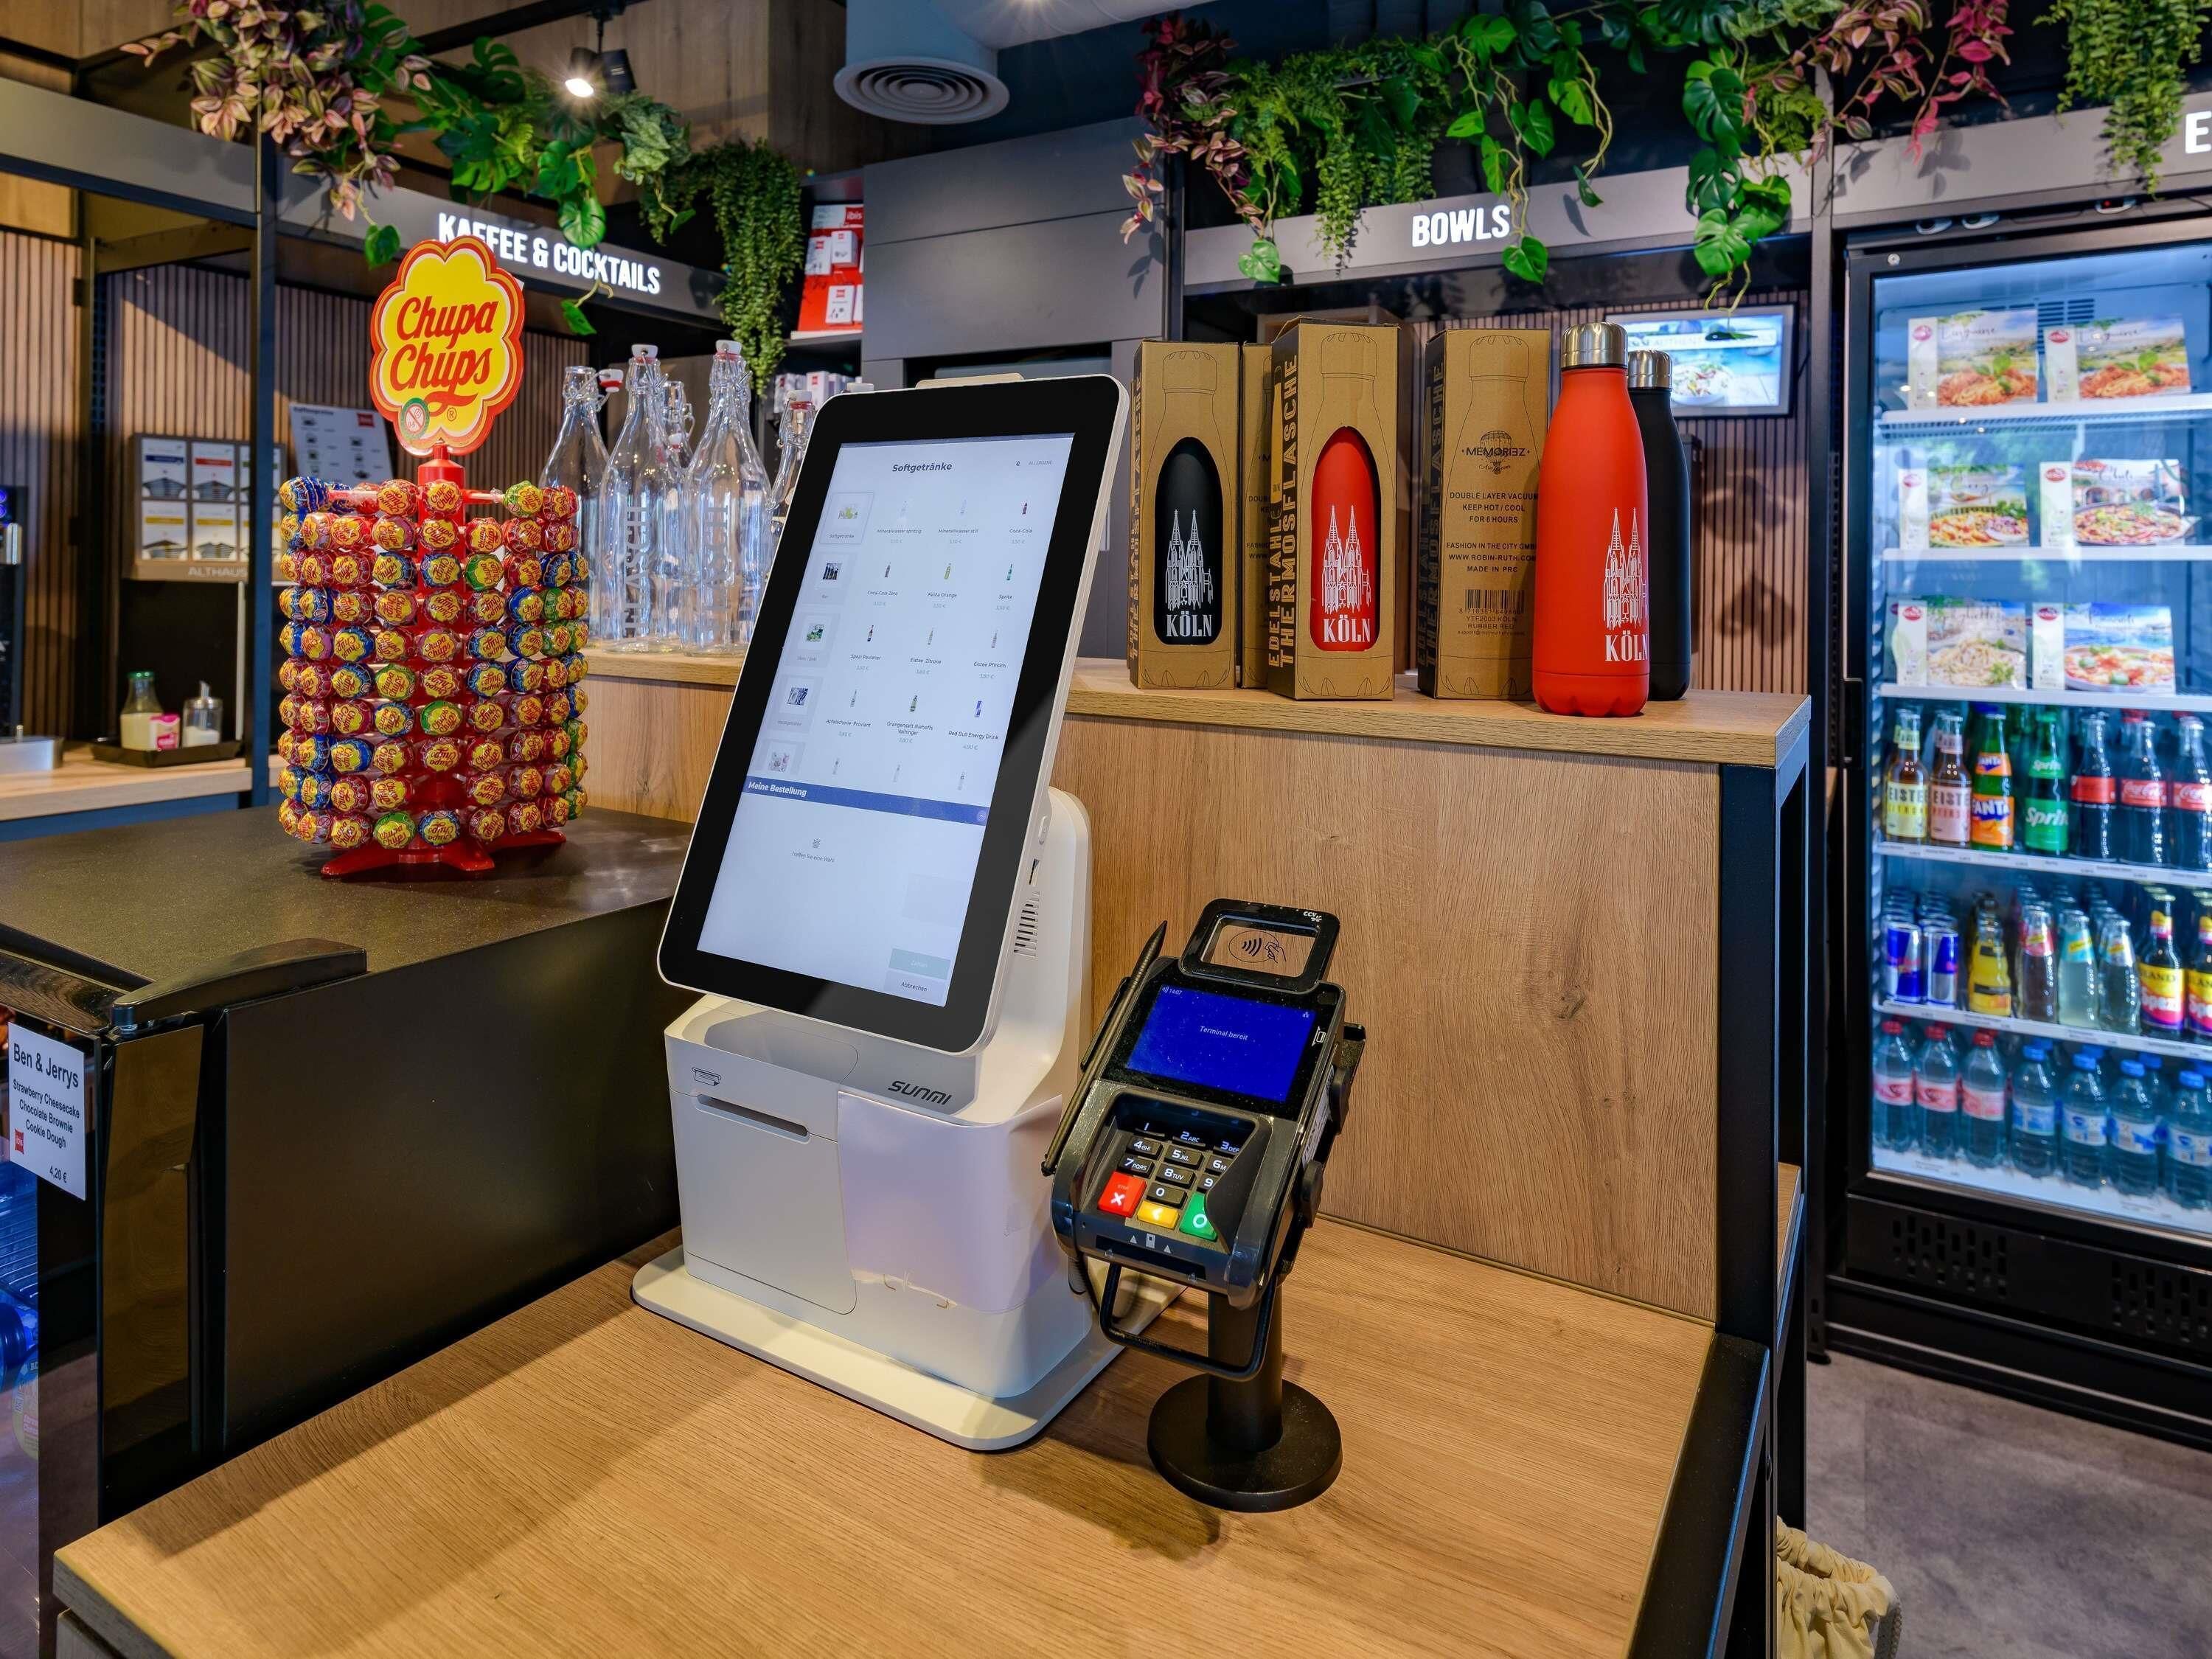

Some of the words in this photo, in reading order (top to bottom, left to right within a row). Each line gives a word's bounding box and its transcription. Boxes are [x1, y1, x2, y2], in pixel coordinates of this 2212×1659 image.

[1411, 204, 1510, 247] BOWLS
[438, 212, 528, 264] KAFFEE
[532, 237, 549, 268] &
[554, 243, 661, 294] COCKTAILS
[396, 296, 499, 349] Chupa
[389, 341, 493, 404] Chups
[892, 462, 953, 473] Softgetränke
[1281, 355, 1298, 668] THERMOSFLASCHE
[1450, 492, 1480, 500] DOUBLE
[1268, 518, 1282, 668] EDELSTAHL
[1166, 611, 1212, 637] KÖLN
[1324, 615, 1371, 643] KÖLN
[1605, 630, 1649, 661] KÖLN
[748, 781, 769, 792] Meine
[770, 783, 807, 798] Bestellung
[901, 981, 928, 992] Abbrechen
[1200, 1026, 1228, 1037] Terminal
[1228, 1031, 1248, 1040] bereit
[13, 1043, 32, 1068] Ben
[35, 1052, 43, 1074] &
[46, 1057, 79, 1090] Jerrys
[13, 1079, 43, 1104] Strawberry
[44, 1092, 80, 1119] Cheesecake
[19, 1099, 47, 1121] Chocolate
[49, 1112, 73, 1133] Brownie
[26, 1119, 45, 1138] Cookie
[46, 1130, 66, 1149] Dough
